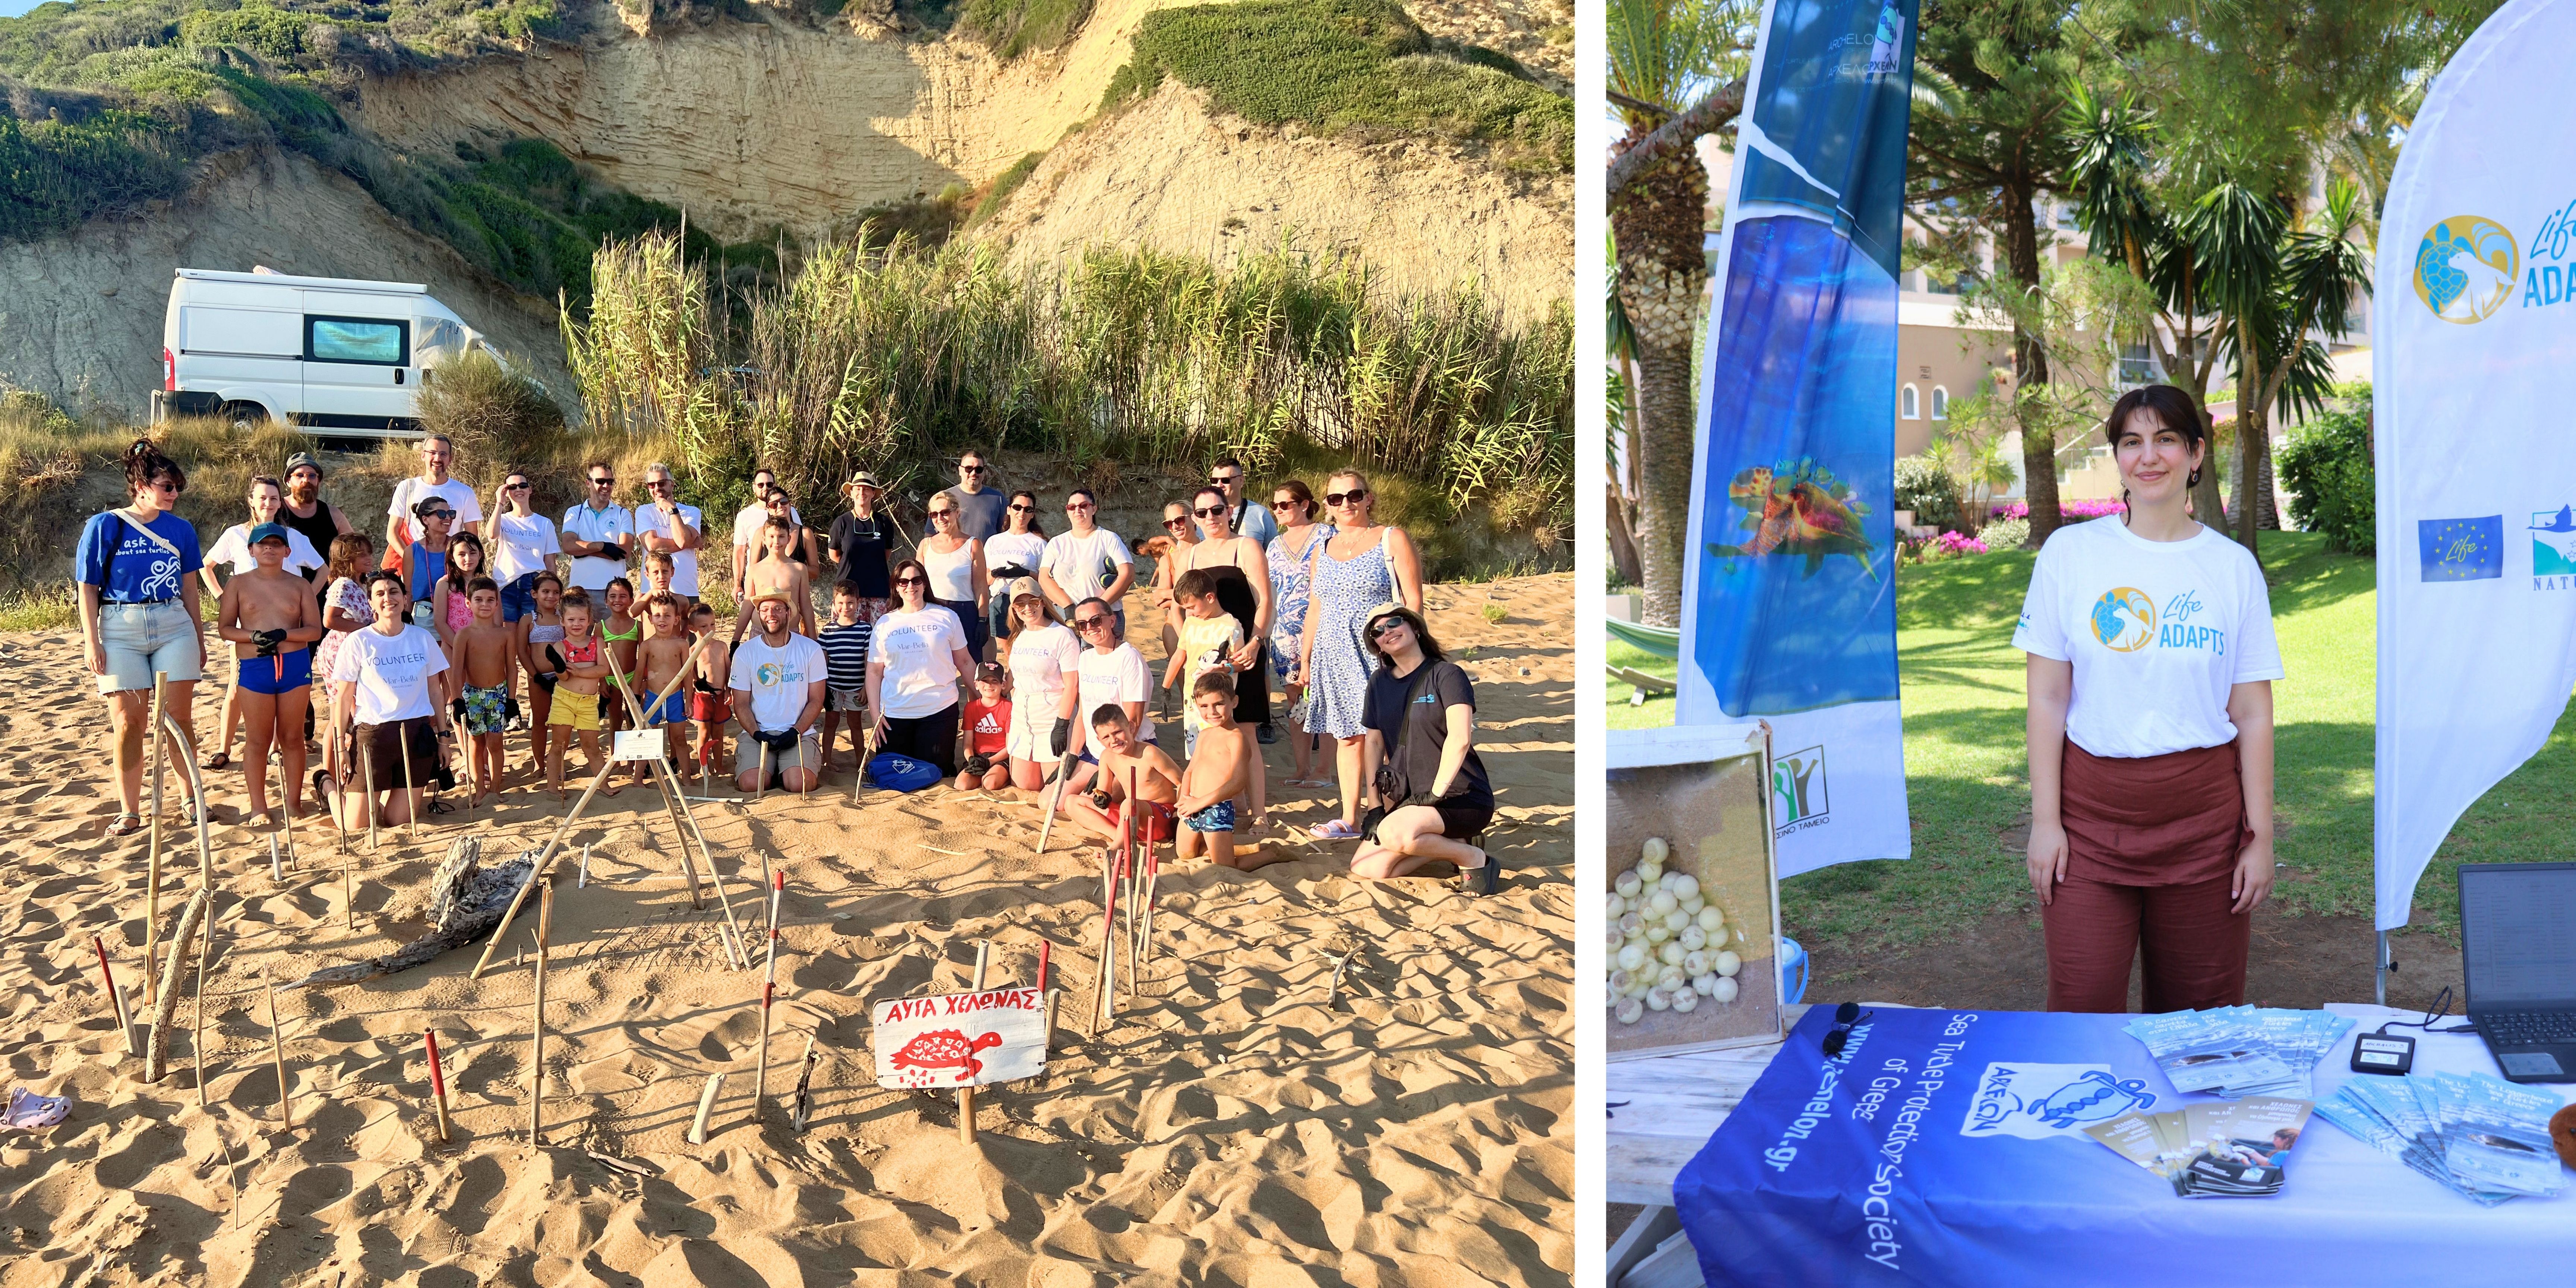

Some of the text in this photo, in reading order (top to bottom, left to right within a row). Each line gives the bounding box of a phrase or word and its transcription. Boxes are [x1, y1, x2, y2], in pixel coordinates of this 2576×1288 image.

[1828, 33, 1874, 51] ARCHELO
[501, 525, 541, 537] VOLUNTEER
[124, 537, 147, 548] ask
[2446, 534, 2477, 562] Life
[2163, 589, 2203, 621] Life
[887, 625, 938, 638] VOLUNTEER
[897, 642, 929, 650] Mar-Bella
[2159, 624, 2224, 656] ADAPTS
[367, 653, 426, 666] VOLUNTEER
[383, 675, 418, 685] Mar-Bella
[781, 673, 804, 682] ADAPTS
[1798, 817, 1830, 830] ΤΑΜΕΙΟ
[886, 989, 1038, 1023] ΑΥΓΑ ΧΕΛΩΝΑΣ
[1944, 1014, 1978, 1036] Sea
[1882, 1058, 1909, 1073] of
[2440, 1078, 2453, 1086] The
[2488, 1089, 2503, 1097] sea
[2500, 1086, 2553, 1104] Loggerhead
[2503, 1100, 2535, 1111] Greece
[1863, 1163, 1903, 1270] Society
